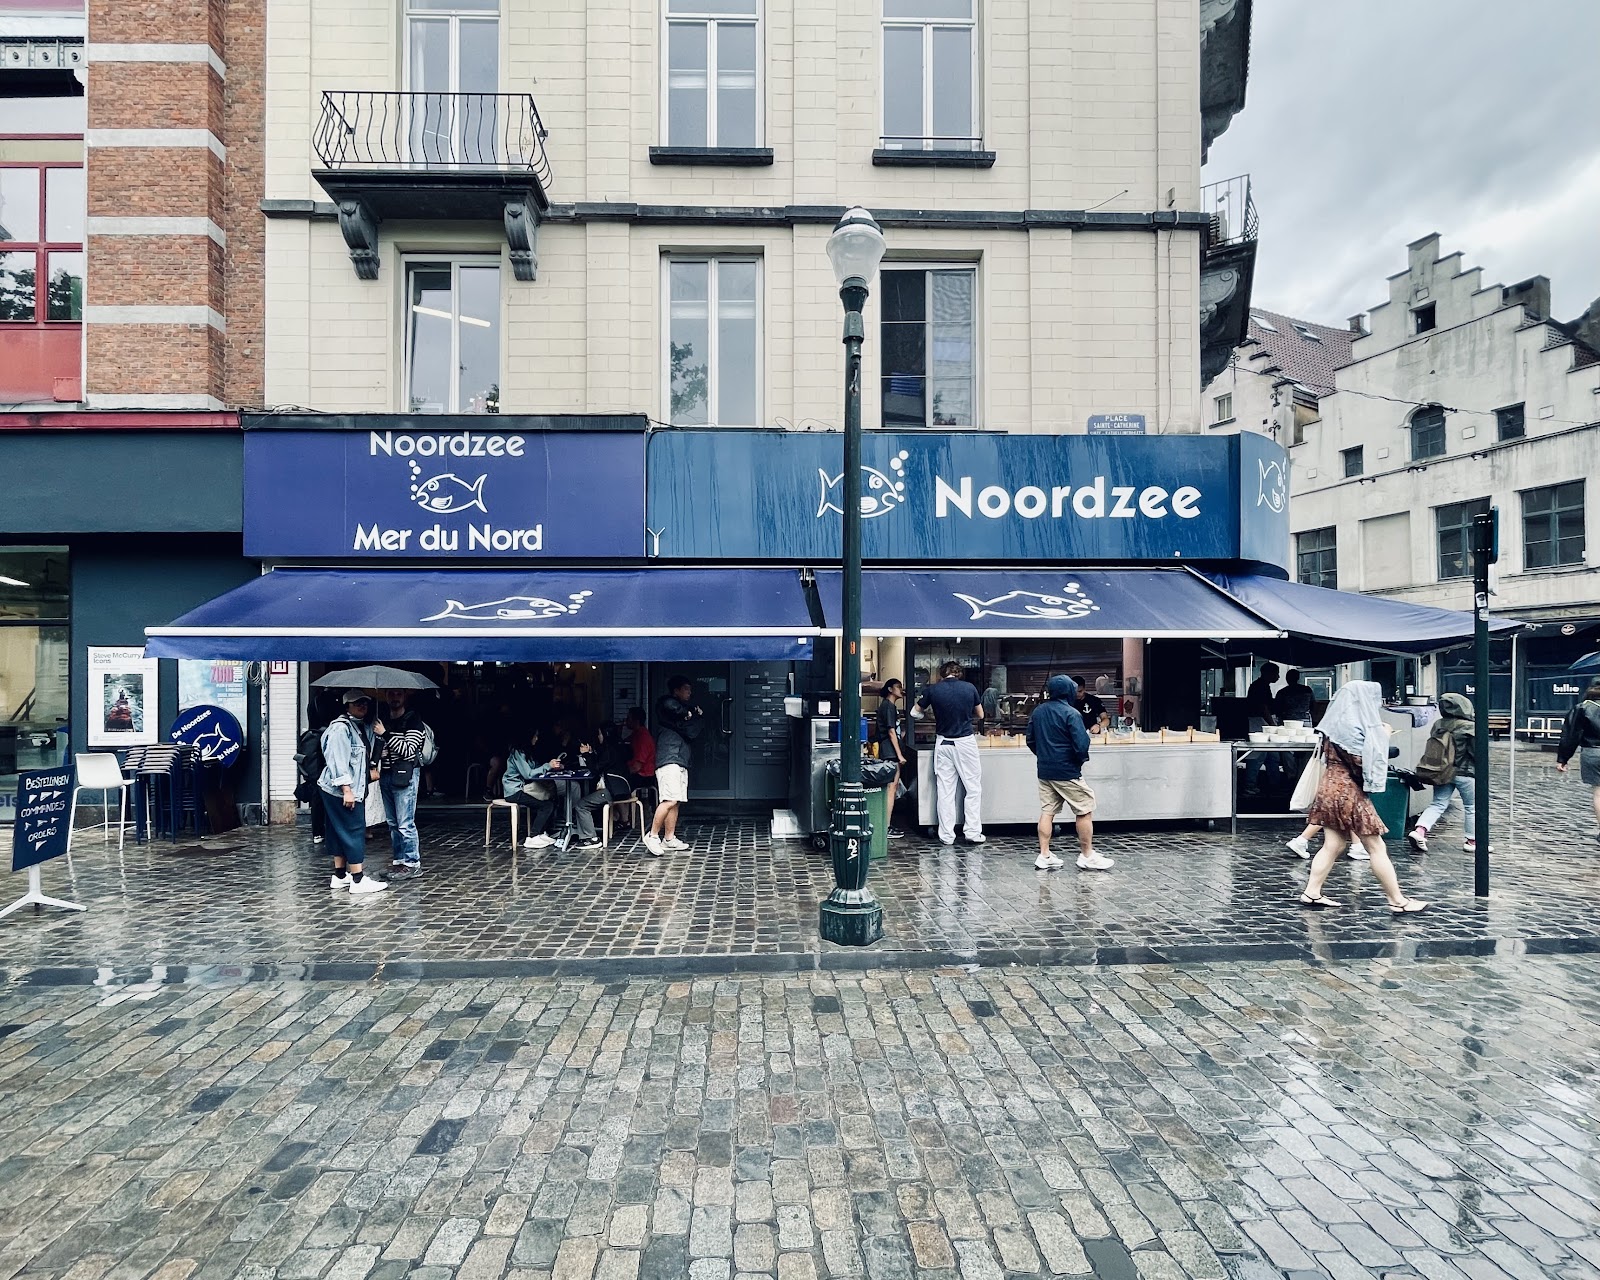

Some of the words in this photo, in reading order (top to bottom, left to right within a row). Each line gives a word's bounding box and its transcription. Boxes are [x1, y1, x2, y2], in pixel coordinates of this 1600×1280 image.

[370, 431, 525, 457] Noordzee
[935, 475, 1202, 519] Noordzee
[353, 523, 412, 551] Mer
[419, 523, 458, 551] du
[468, 523, 543, 551] Nord
[112, 652, 142, 660] McCurry
[1552, 683, 1580, 693] billie
[171, 731, 182, 739] De
[181, 709, 212, 733] Noordzee
[222, 742, 240, 756] Nord
[20, 800, 66, 818] COMMANDES
[28, 826, 57, 843] ORDERS
